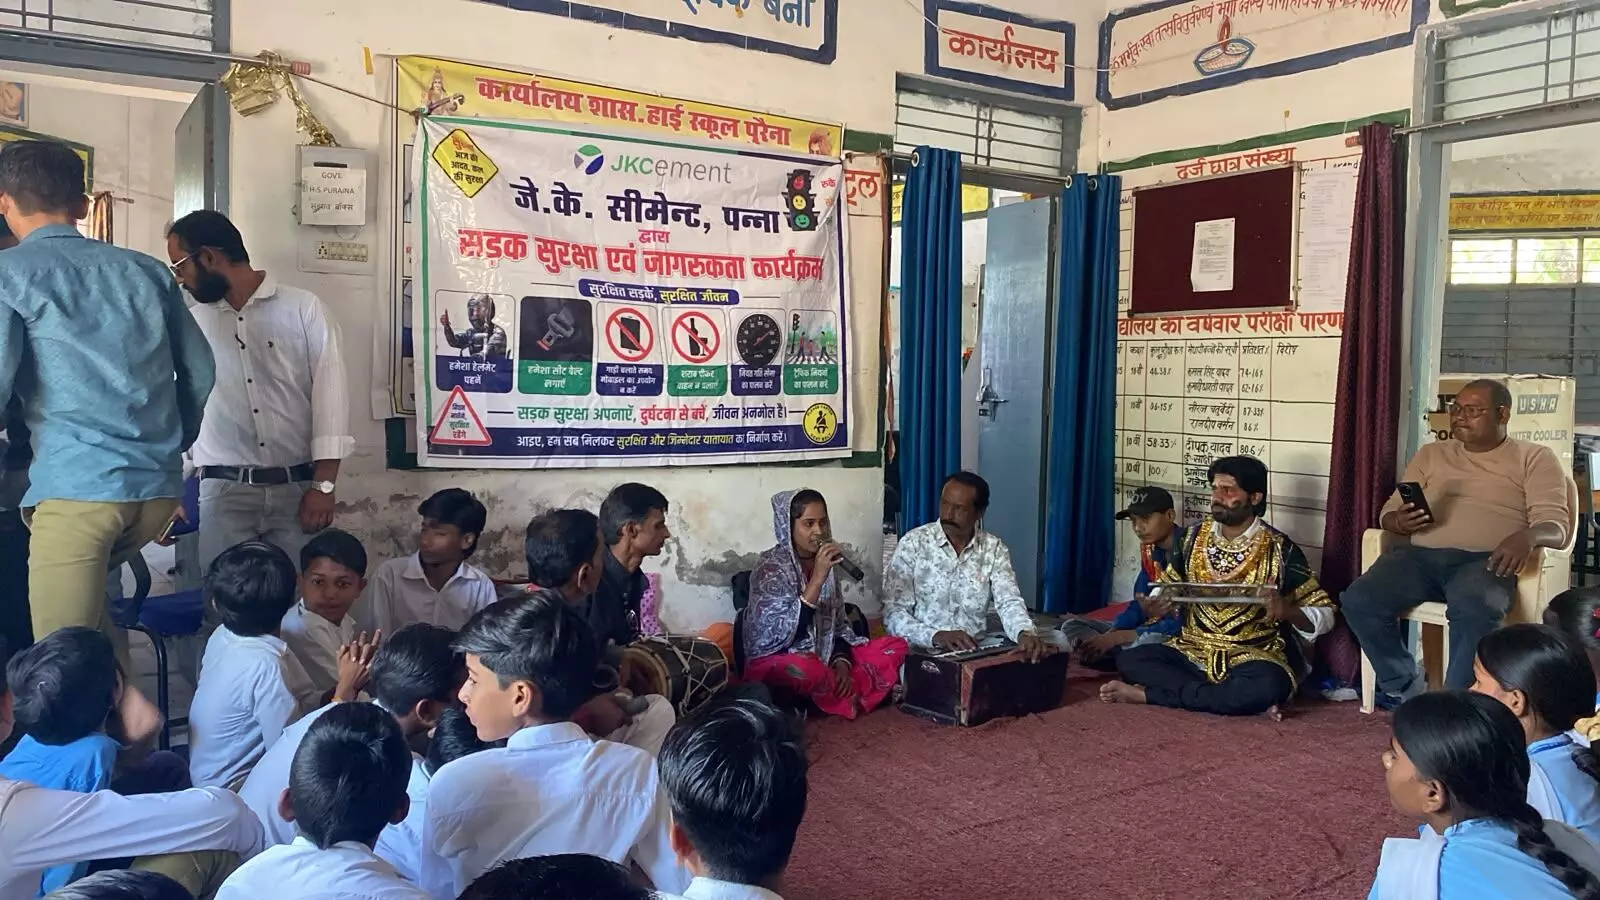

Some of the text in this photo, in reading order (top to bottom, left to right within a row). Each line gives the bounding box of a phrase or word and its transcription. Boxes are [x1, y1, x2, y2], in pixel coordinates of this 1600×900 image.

[941, 26, 1059, 74] कार्यालय
[475, 77, 584, 113] कार्यालय
[688, 112, 741, 140] स्कूल
[455, 151, 479, 163] आज की
[1175, 147, 1296, 181] दर्ज छात्र संख्या
[453, 172, 484, 185] की सुरक्षा
[609, 154, 732, 184] JKCement
[607, 187, 711, 234] सीमेन्ट,
[722, 206, 780, 234] पन्ना
[638, 228, 670, 244] द्वारा
[457, 229, 529, 268] सड़क
[535, 236, 598, 275] सुरक्षा
[604, 243, 636, 274] एवं
[751, 249, 825, 281] कार्यक्रम
[589, 282, 626, 299] सुरक्षित
[659, 287, 698, 304] सुरक्षित
[700, 290, 729, 302] जीवन
[1118, 318, 1159, 336] द्यालय
[1160, 316, 1184, 335] का
[449, 361, 497, 373] हमेशा हेलमेट
[527, 364, 550, 375] हमेशा
[552, 364, 567, 375] सीट
[626, 376, 635, 384] का
[1518, 395, 1557, 412] USHA
[516, 406, 550, 424] सड़क
[553, 406, 591, 425] सुरक्षा
[640, 404, 676, 426] दुर्घटना
[679, 404, 689, 420] से
[712, 404, 739, 420] जीवन
[741, 403, 775, 420] अनमोल
[547, 436, 561, 447] हम
[563, 436, 579, 446] सब
[581, 434, 615, 447] मिलकर
[616, 434, 647, 450] सुरक्षित
[649, 434, 665, 446] और
[703, 434, 734, 445] यातायात
[735, 434, 745, 444] का
[746, 431, 771, 444] निर्माण
[1533, 430, 1568, 441] COOLER
[1185, 437, 1209, 454] दीपक
[1210, 442, 1234, 456] यादव
